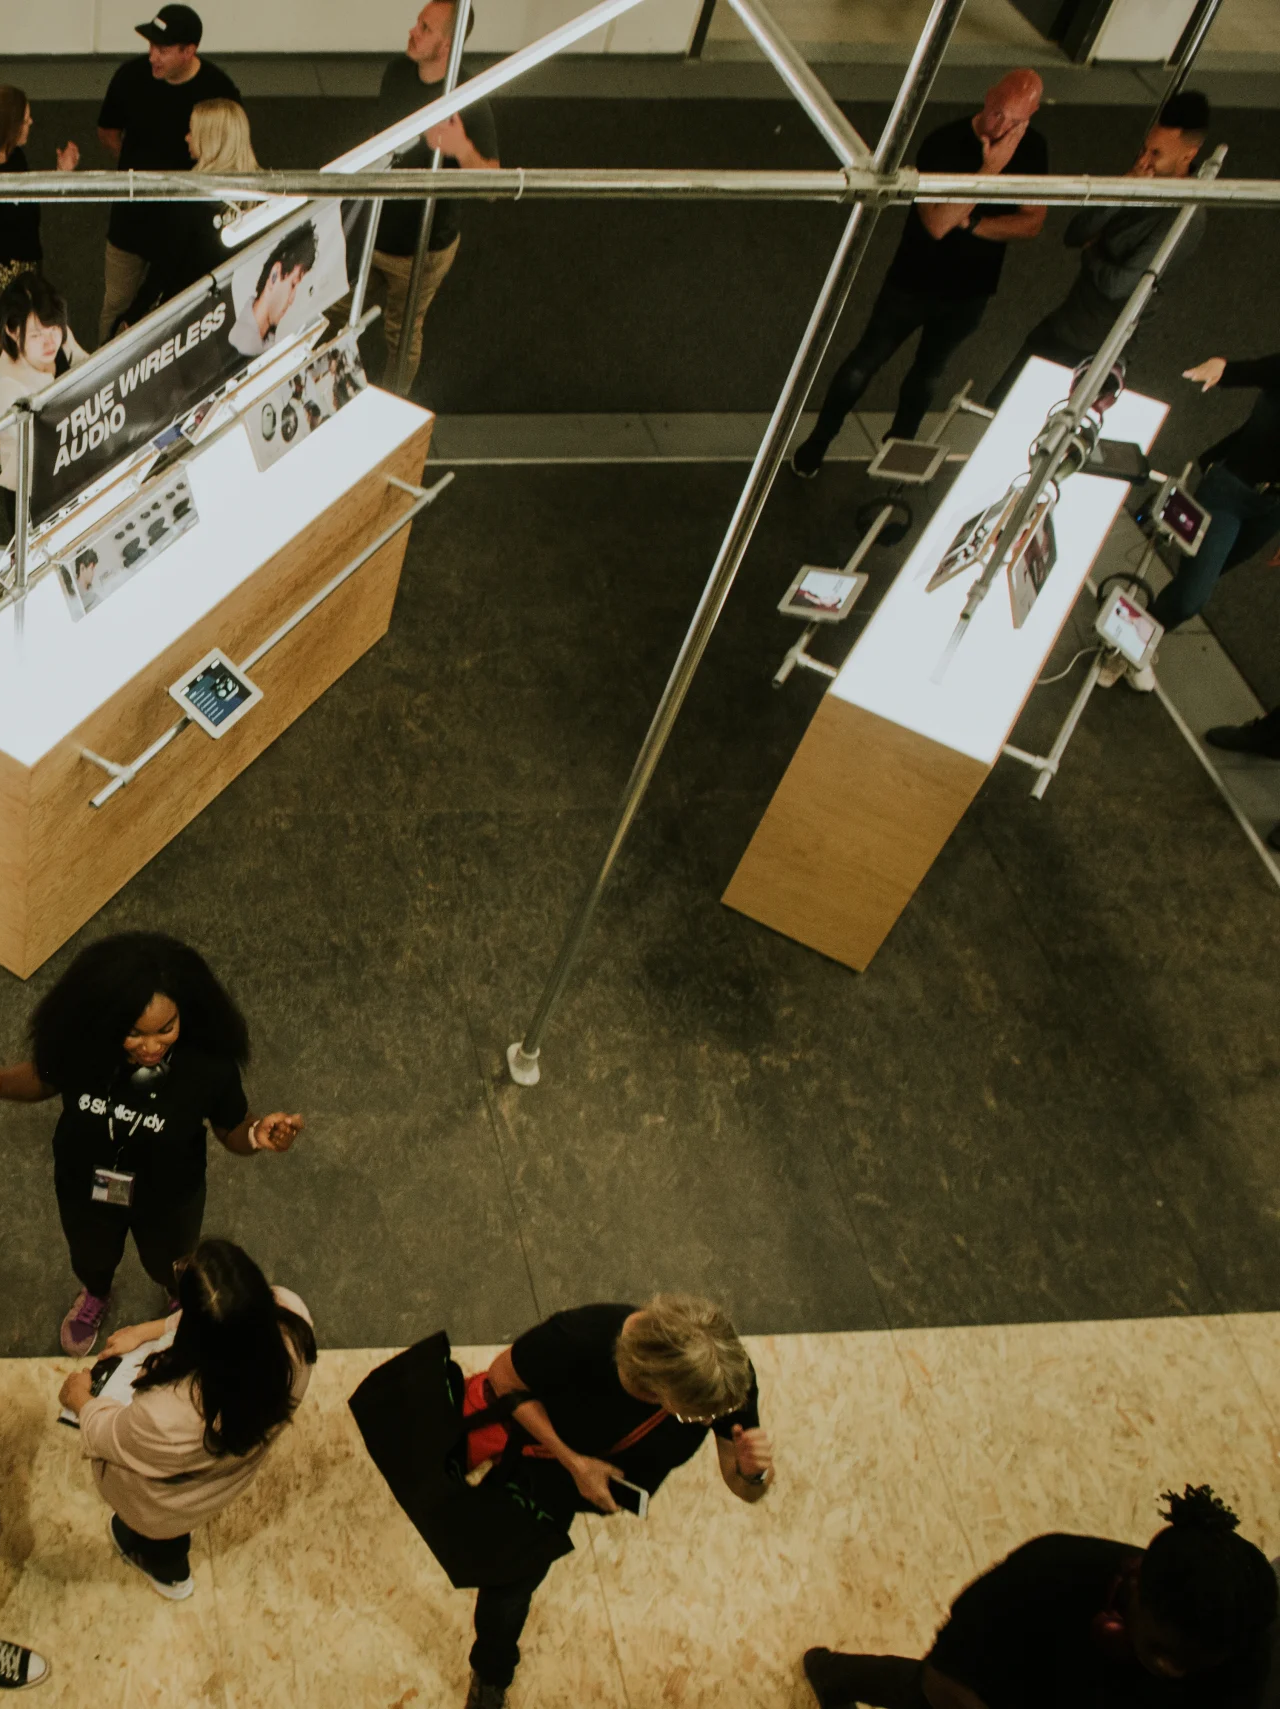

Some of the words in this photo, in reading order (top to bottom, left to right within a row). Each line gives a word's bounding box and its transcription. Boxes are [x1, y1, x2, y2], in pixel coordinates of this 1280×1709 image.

[56, 381, 116, 446] TRUE
[119, 302, 226, 398] WIRELESS
[53, 403, 126, 476] AUDIO
[89, 1098, 166, 1133] Skllcady
